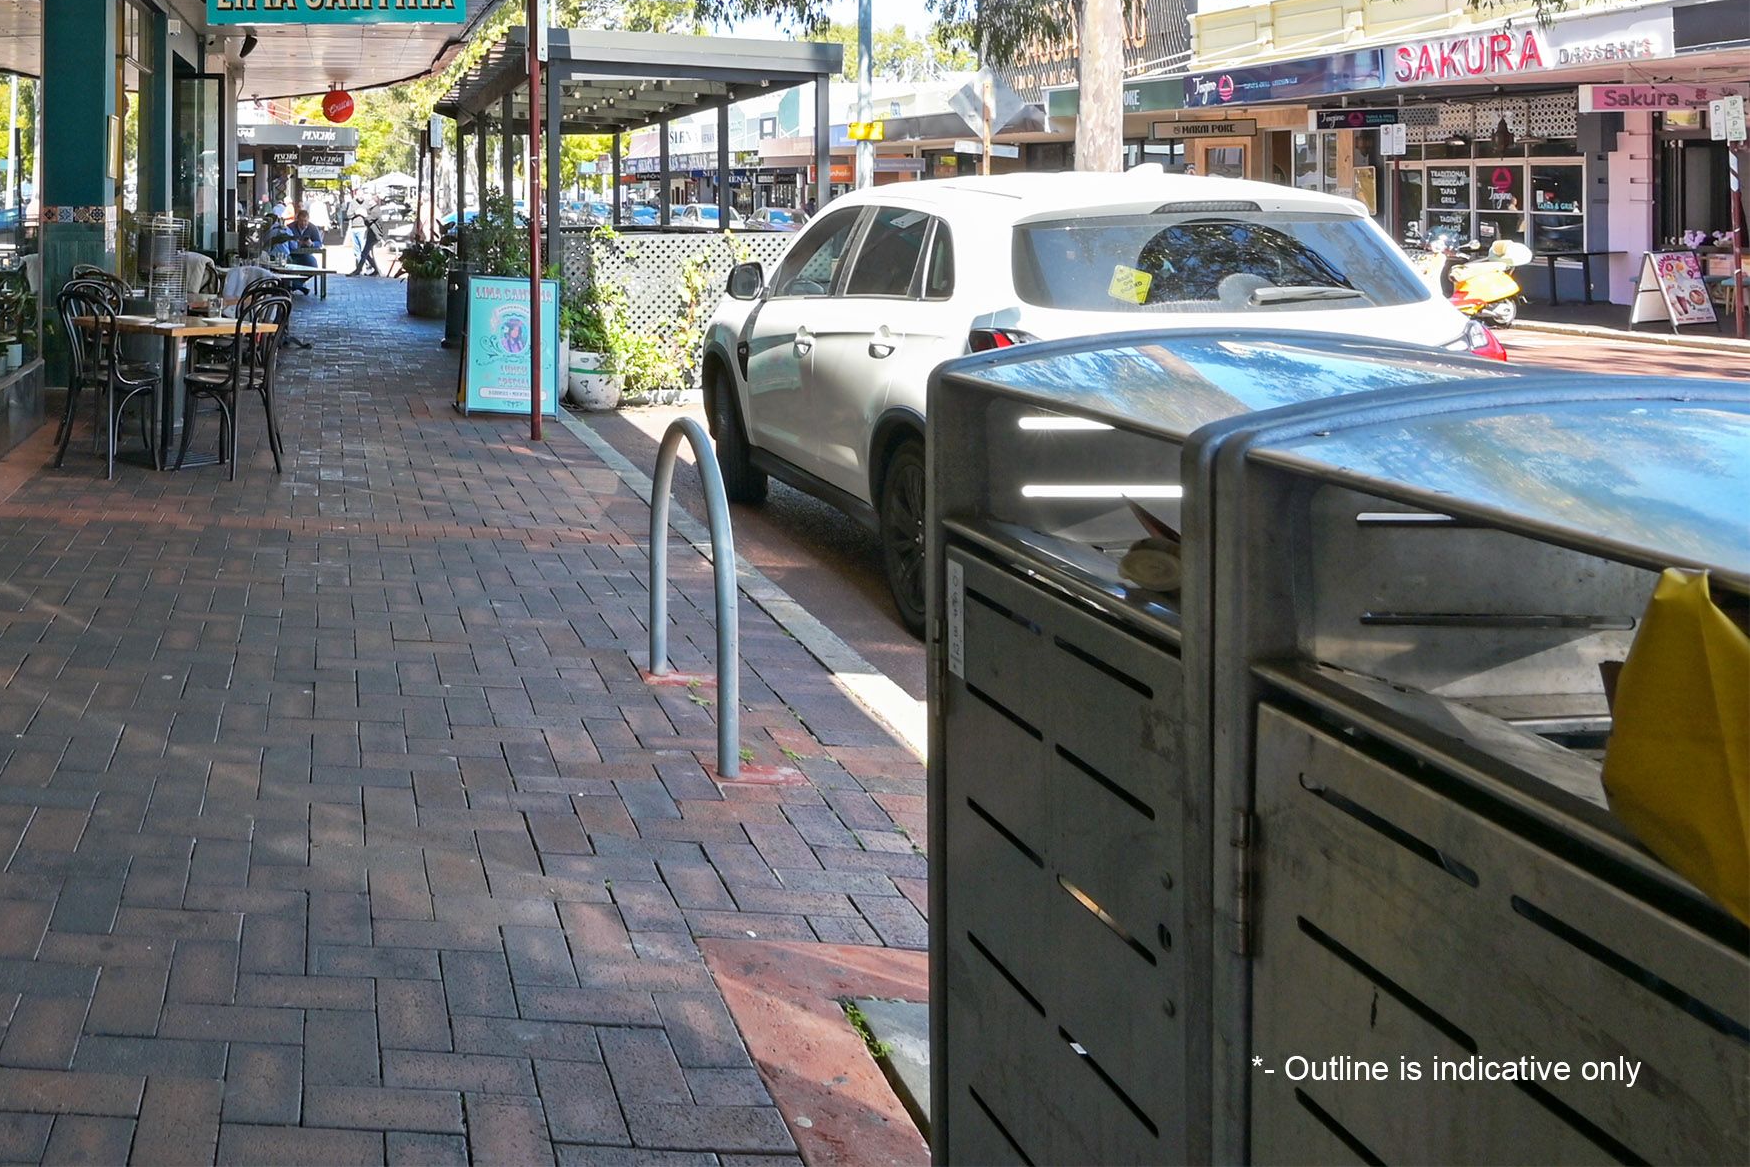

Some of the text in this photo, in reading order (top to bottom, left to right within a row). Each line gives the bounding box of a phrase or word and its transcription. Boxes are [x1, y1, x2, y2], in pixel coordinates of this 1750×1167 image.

[1395, 30, 1543, 82] SAKURA
[1604, 88, 1679, 107] Sakura
[1211, 123, 1235, 133] POKE
